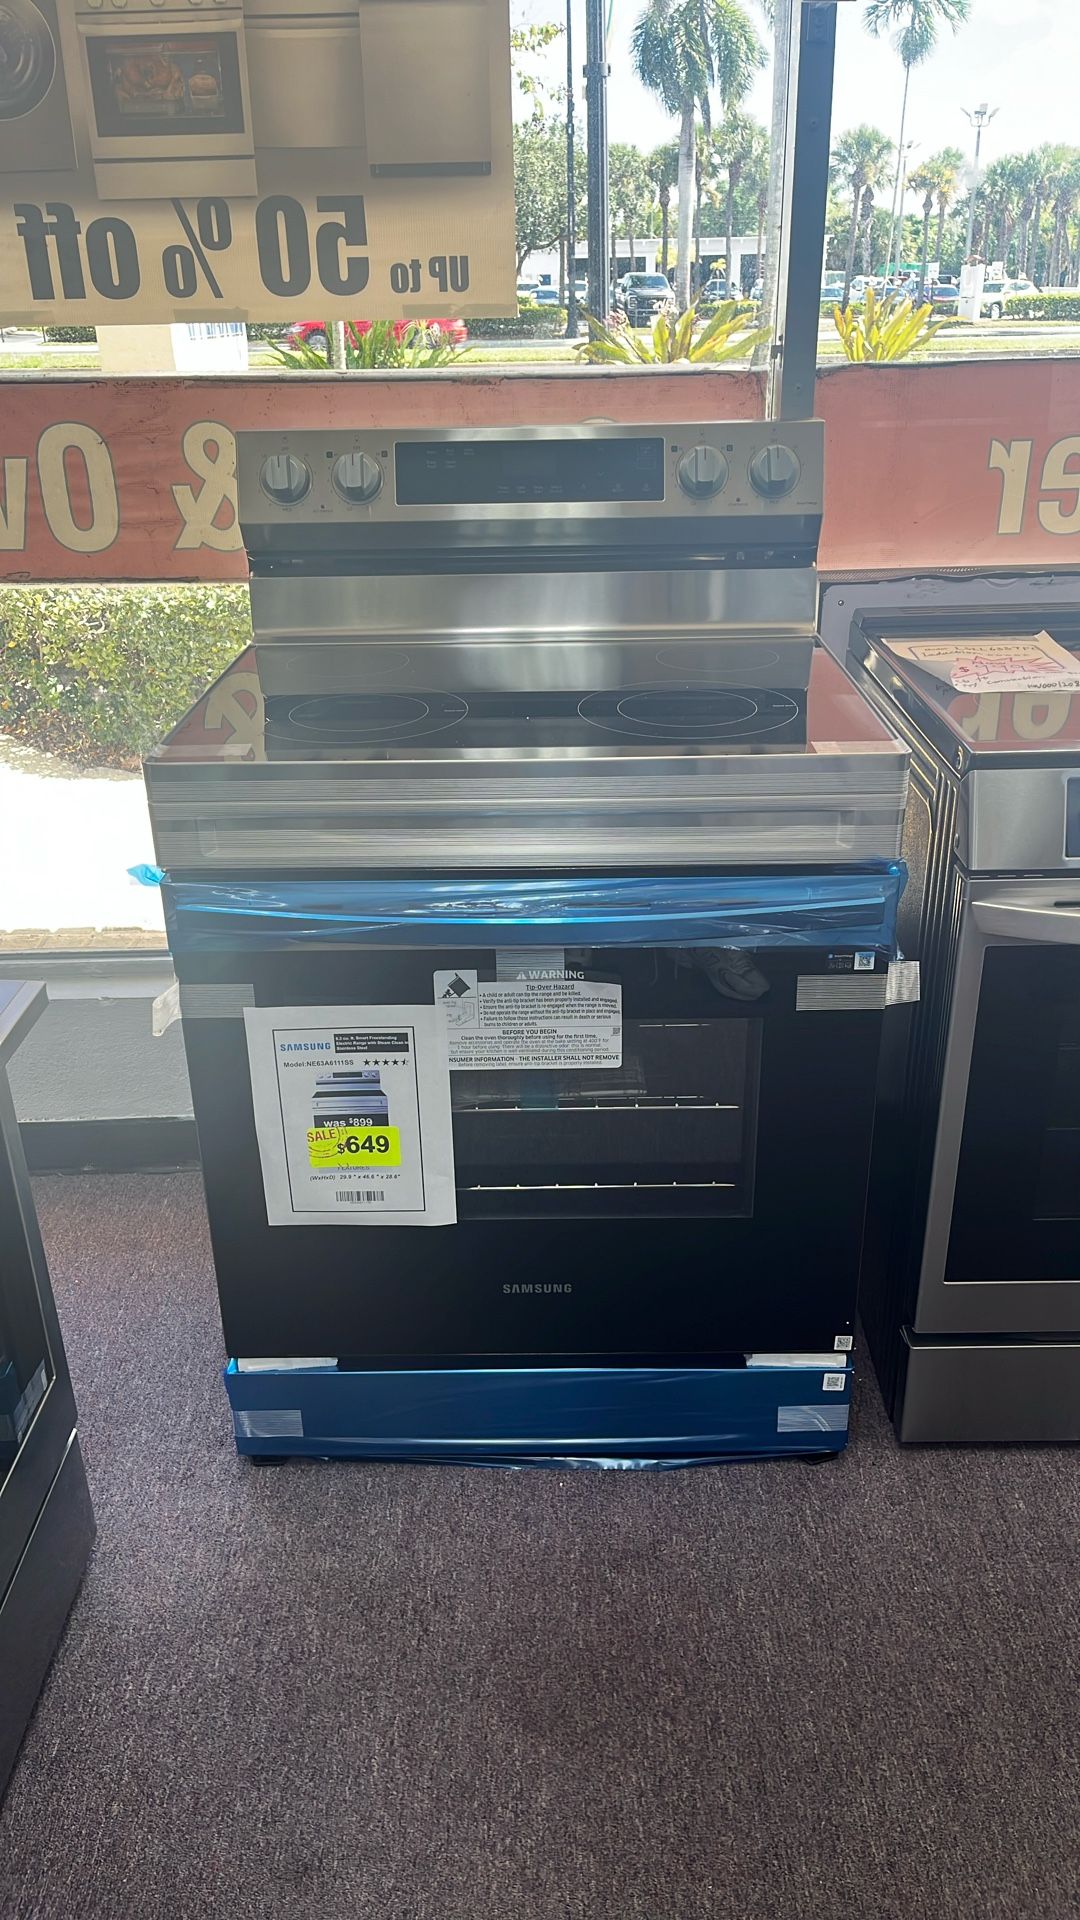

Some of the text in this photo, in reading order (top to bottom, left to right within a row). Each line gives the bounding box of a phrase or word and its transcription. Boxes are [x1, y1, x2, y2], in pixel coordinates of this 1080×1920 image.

[528, 969, 585, 980] WARNING
[280, 1042, 331, 1052] SAMSUNG
[349, 1118, 373, 1127] $899
[306, 1128, 337, 1143] SALE
[337, 1134, 390, 1155] $649
[502, 1283, 573, 1294] SAMSUNG
